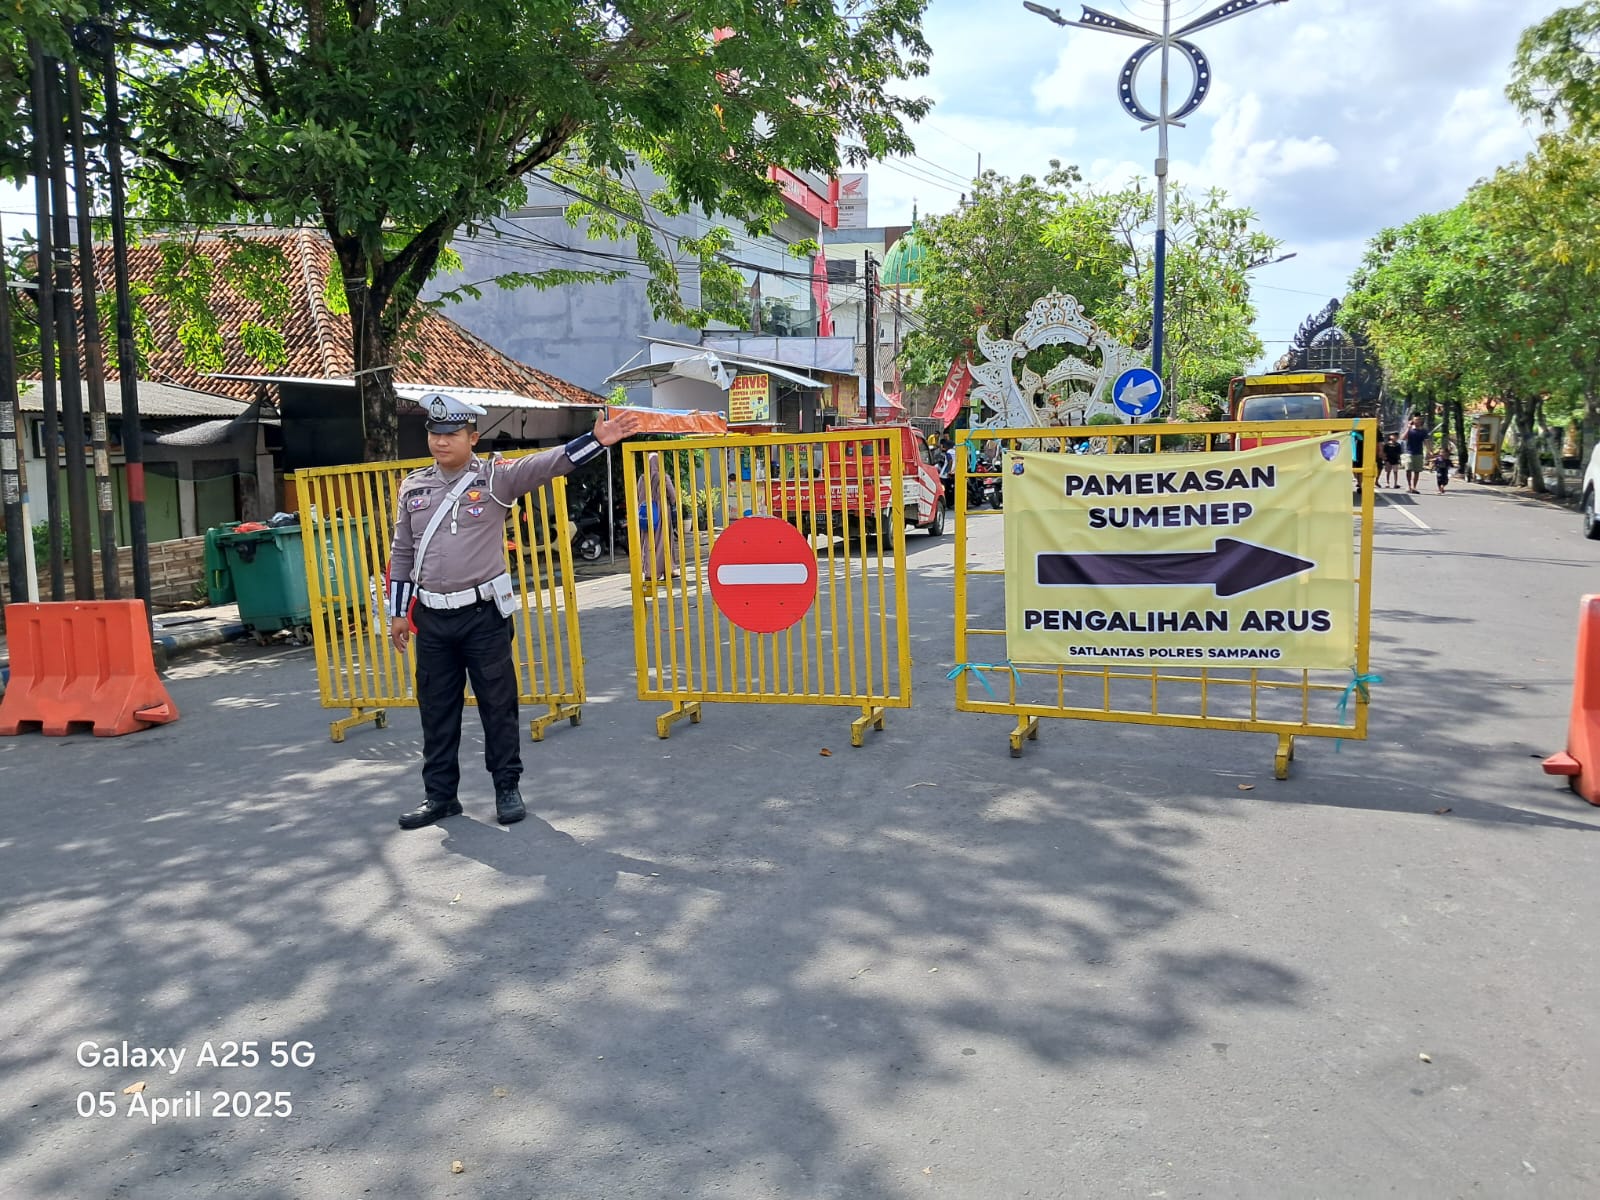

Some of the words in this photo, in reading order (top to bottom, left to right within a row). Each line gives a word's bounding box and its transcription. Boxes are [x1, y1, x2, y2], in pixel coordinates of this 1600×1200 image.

[1065, 465, 1276, 496] PAMEKASAN
[1089, 502, 1253, 529] SUMENEP
[1024, 609, 1229, 632] PENGALIHAN
[1240, 609, 1332, 632] ARUS
[1069, 645, 1145, 658] SATLANTAS
[1149, 648, 1203, 658] POLRES
[1208, 648, 1281, 659] SAMPANG
